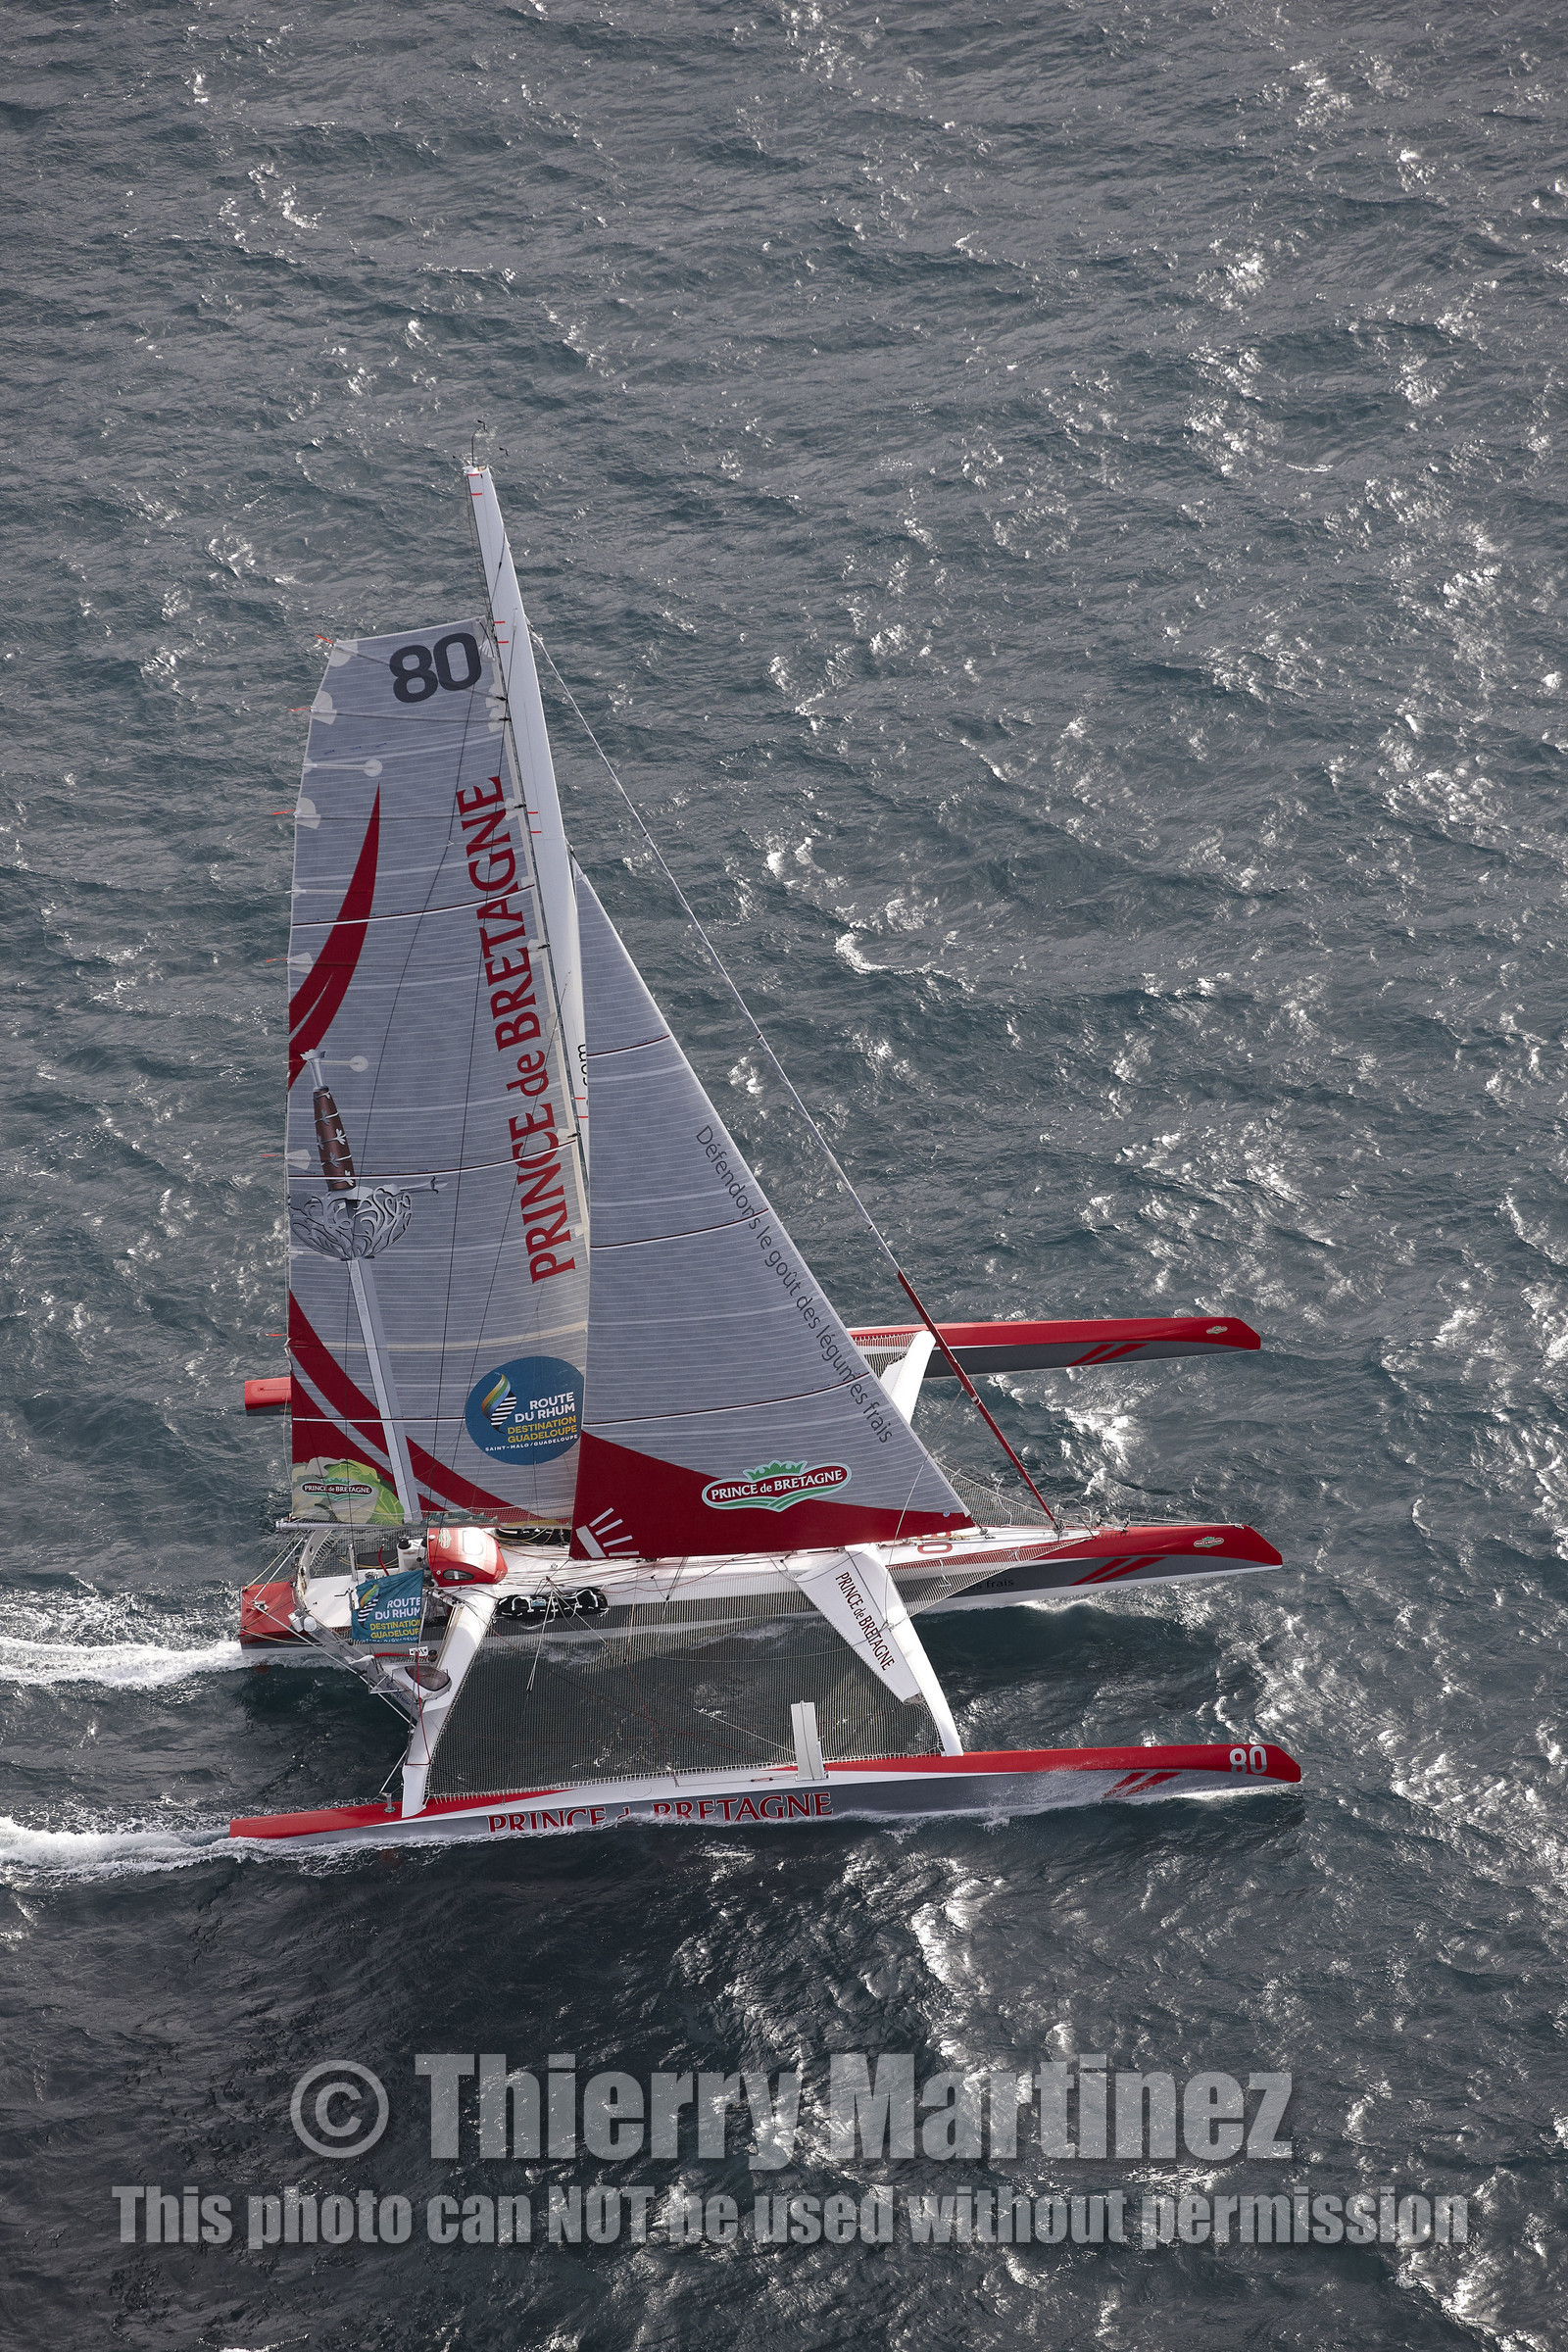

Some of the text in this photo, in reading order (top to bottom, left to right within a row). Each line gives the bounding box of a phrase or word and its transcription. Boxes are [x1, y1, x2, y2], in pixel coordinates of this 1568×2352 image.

[389, 632, 481, 703] 80
[456, 775, 576, 1284] PRINCE de BRETAGNE
[696, 1125, 892, 1443] Défendons le goût des légumes frais
[529, 1392, 574, 1409] ROUTE
[514, 1402, 575, 1423] DU RHUM
[507, 1415, 576, 1435] DESTINATION
[507, 1425, 577, 1444] GUADELOUPE
[710, 1470, 844, 1500] PRINCE de BRETAGNE
[986, 1578, 1014, 1589] frais
[387, 1596, 421, 1608] ROUTE
[374, 1609, 390, 1620] DU
[835, 1571, 895, 1671] PRINCE de BRETAGNE
[369, 1619, 421, 1631] DESTINATION
[1229, 1745, 1267, 1774] 80
